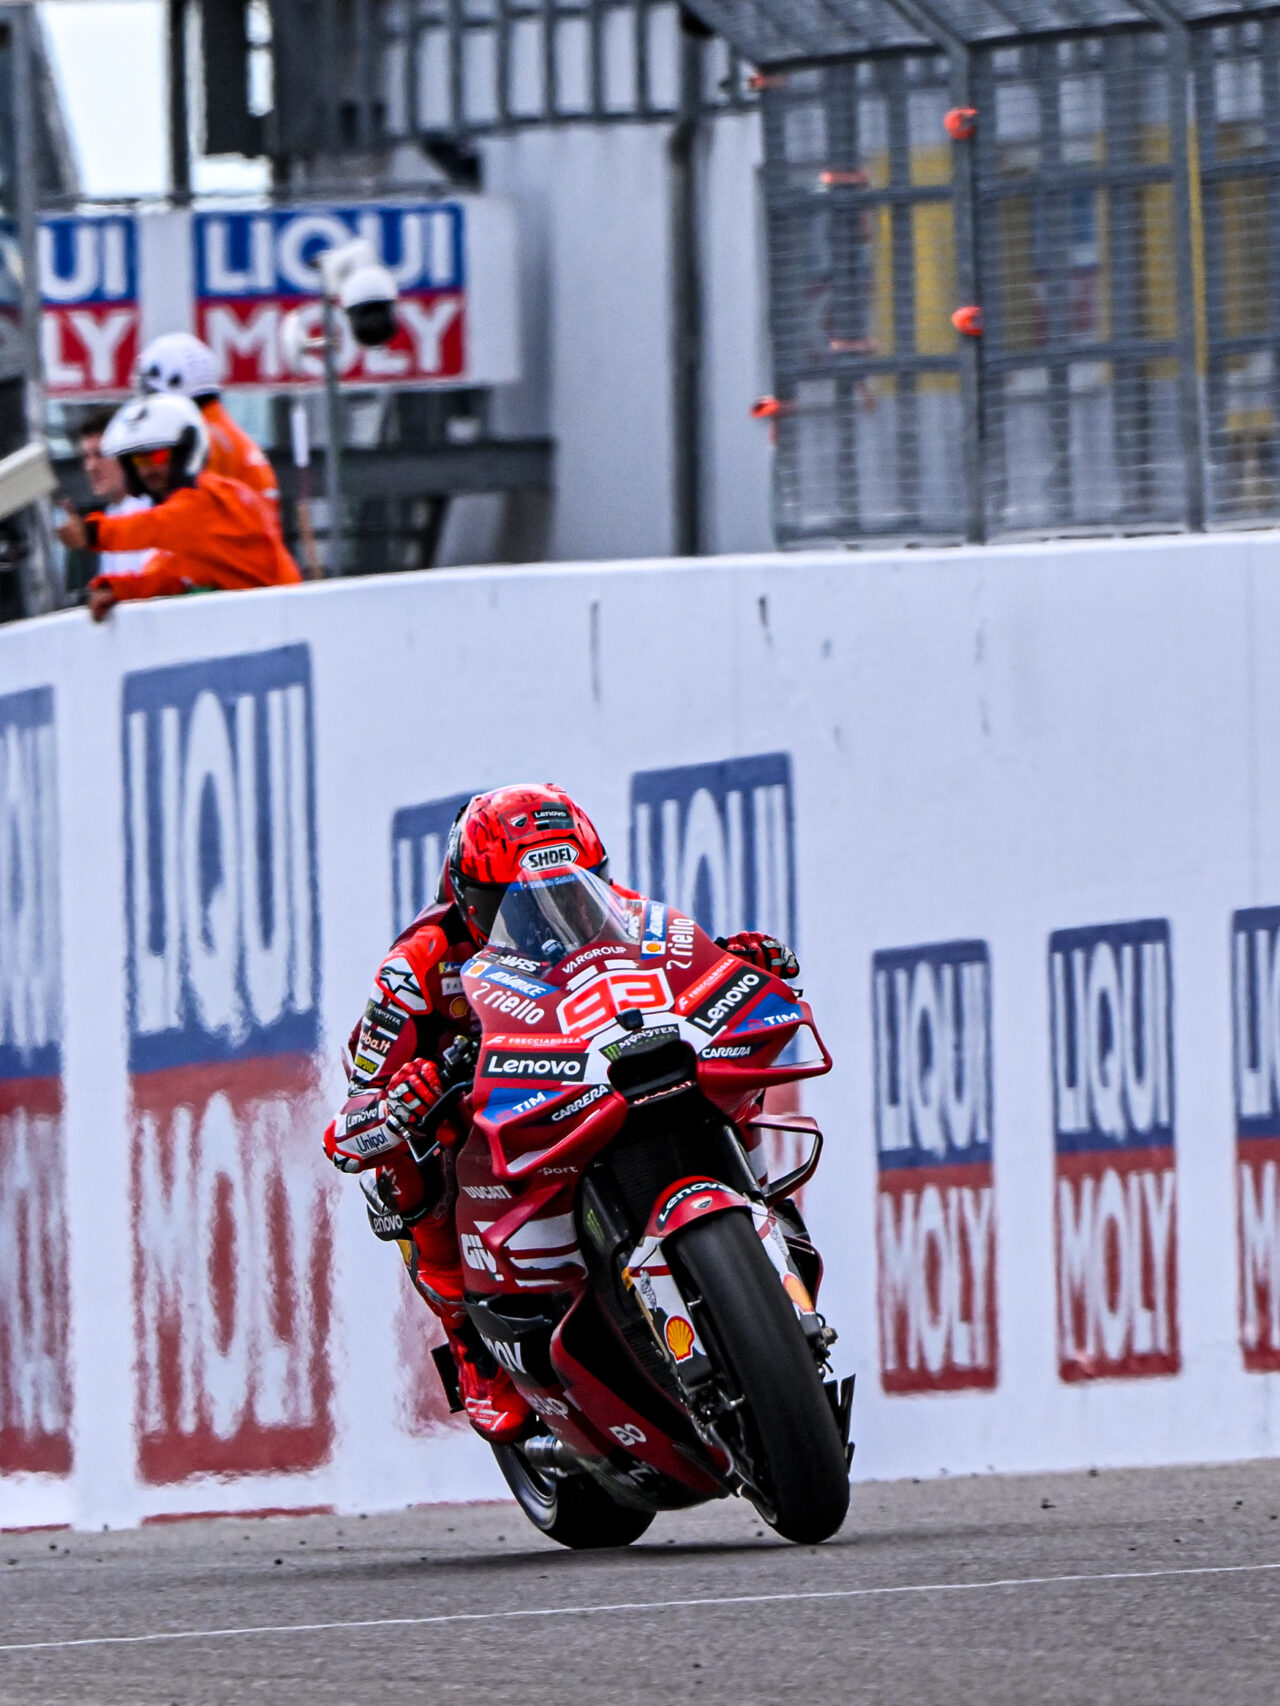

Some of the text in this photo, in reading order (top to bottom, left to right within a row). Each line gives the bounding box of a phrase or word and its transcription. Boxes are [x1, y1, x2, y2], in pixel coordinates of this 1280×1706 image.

[205, 208, 453, 293] LIQUI
[534, 809, 568, 819] Lenovo
[126, 685, 314, 1050] LIQUI
[528, 847, 572, 868] SHOEI
[668, 917, 695, 957] riello
[561, 945, 627, 974] VARGROUP
[483, 990, 545, 1026] riello
[562, 973, 668, 1037] 93
[694, 973, 760, 1030] Lenovo
[764, 1012, 800, 1026] TIM
[618, 1026, 678, 1050] MONSTER
[701, 1045, 752, 1058] CARRERA
[1051, 940, 1169, 1140] LIQUI
[487, 1055, 581, 1076] Lenovo
[875, 958, 992, 1156] LIQUI
[347, 1107, 378, 1129] Lenovo
[512, 1091, 547, 1113] TIM
[551, 1083, 609, 1122] CARRERA
[355, 1128, 389, 1153] Unipol
[461, 1185, 512, 1199] DUCATI
[658, 1182, 734, 1222] Lenovo
[370, 1212, 404, 1234] Lenovo
[132, 1088, 316, 1440] MOLY
[880, 1182, 994, 1375] MOLY
[1058, 1165, 1176, 1362] MOLY
